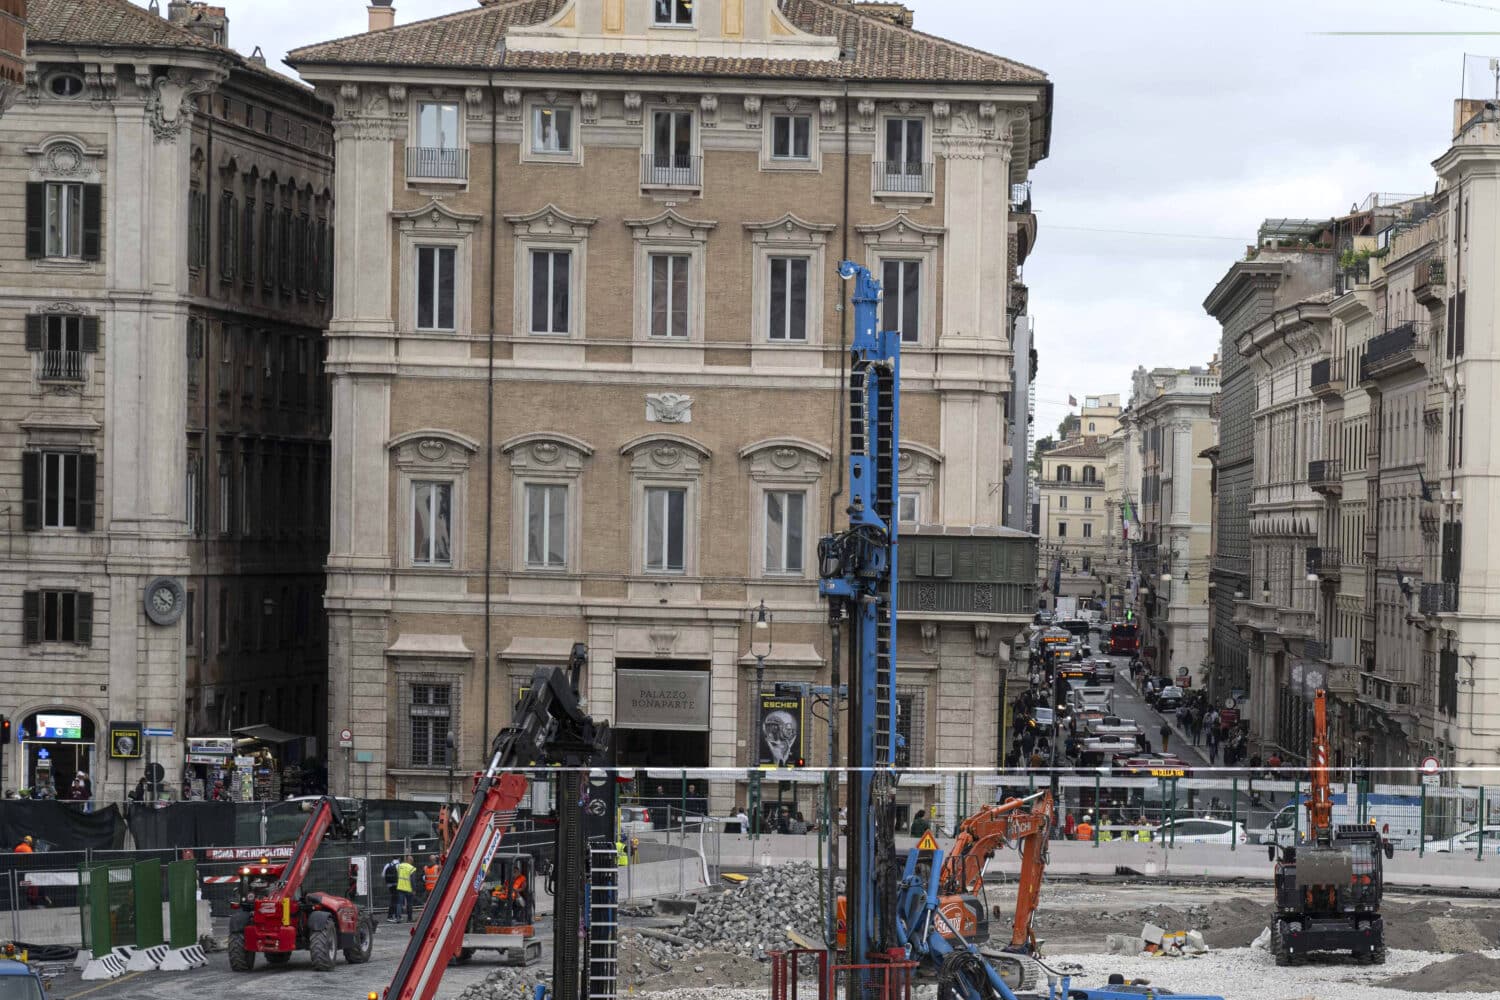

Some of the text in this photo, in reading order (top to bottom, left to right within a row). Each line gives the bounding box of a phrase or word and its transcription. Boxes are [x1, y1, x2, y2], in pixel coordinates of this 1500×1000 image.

[640, 690, 688, 700] PALAZZO
[631, 699, 695, 710] BONAPARTE
[763, 701, 798, 709] ESCHER
[212, 849, 233, 858] ROMA
